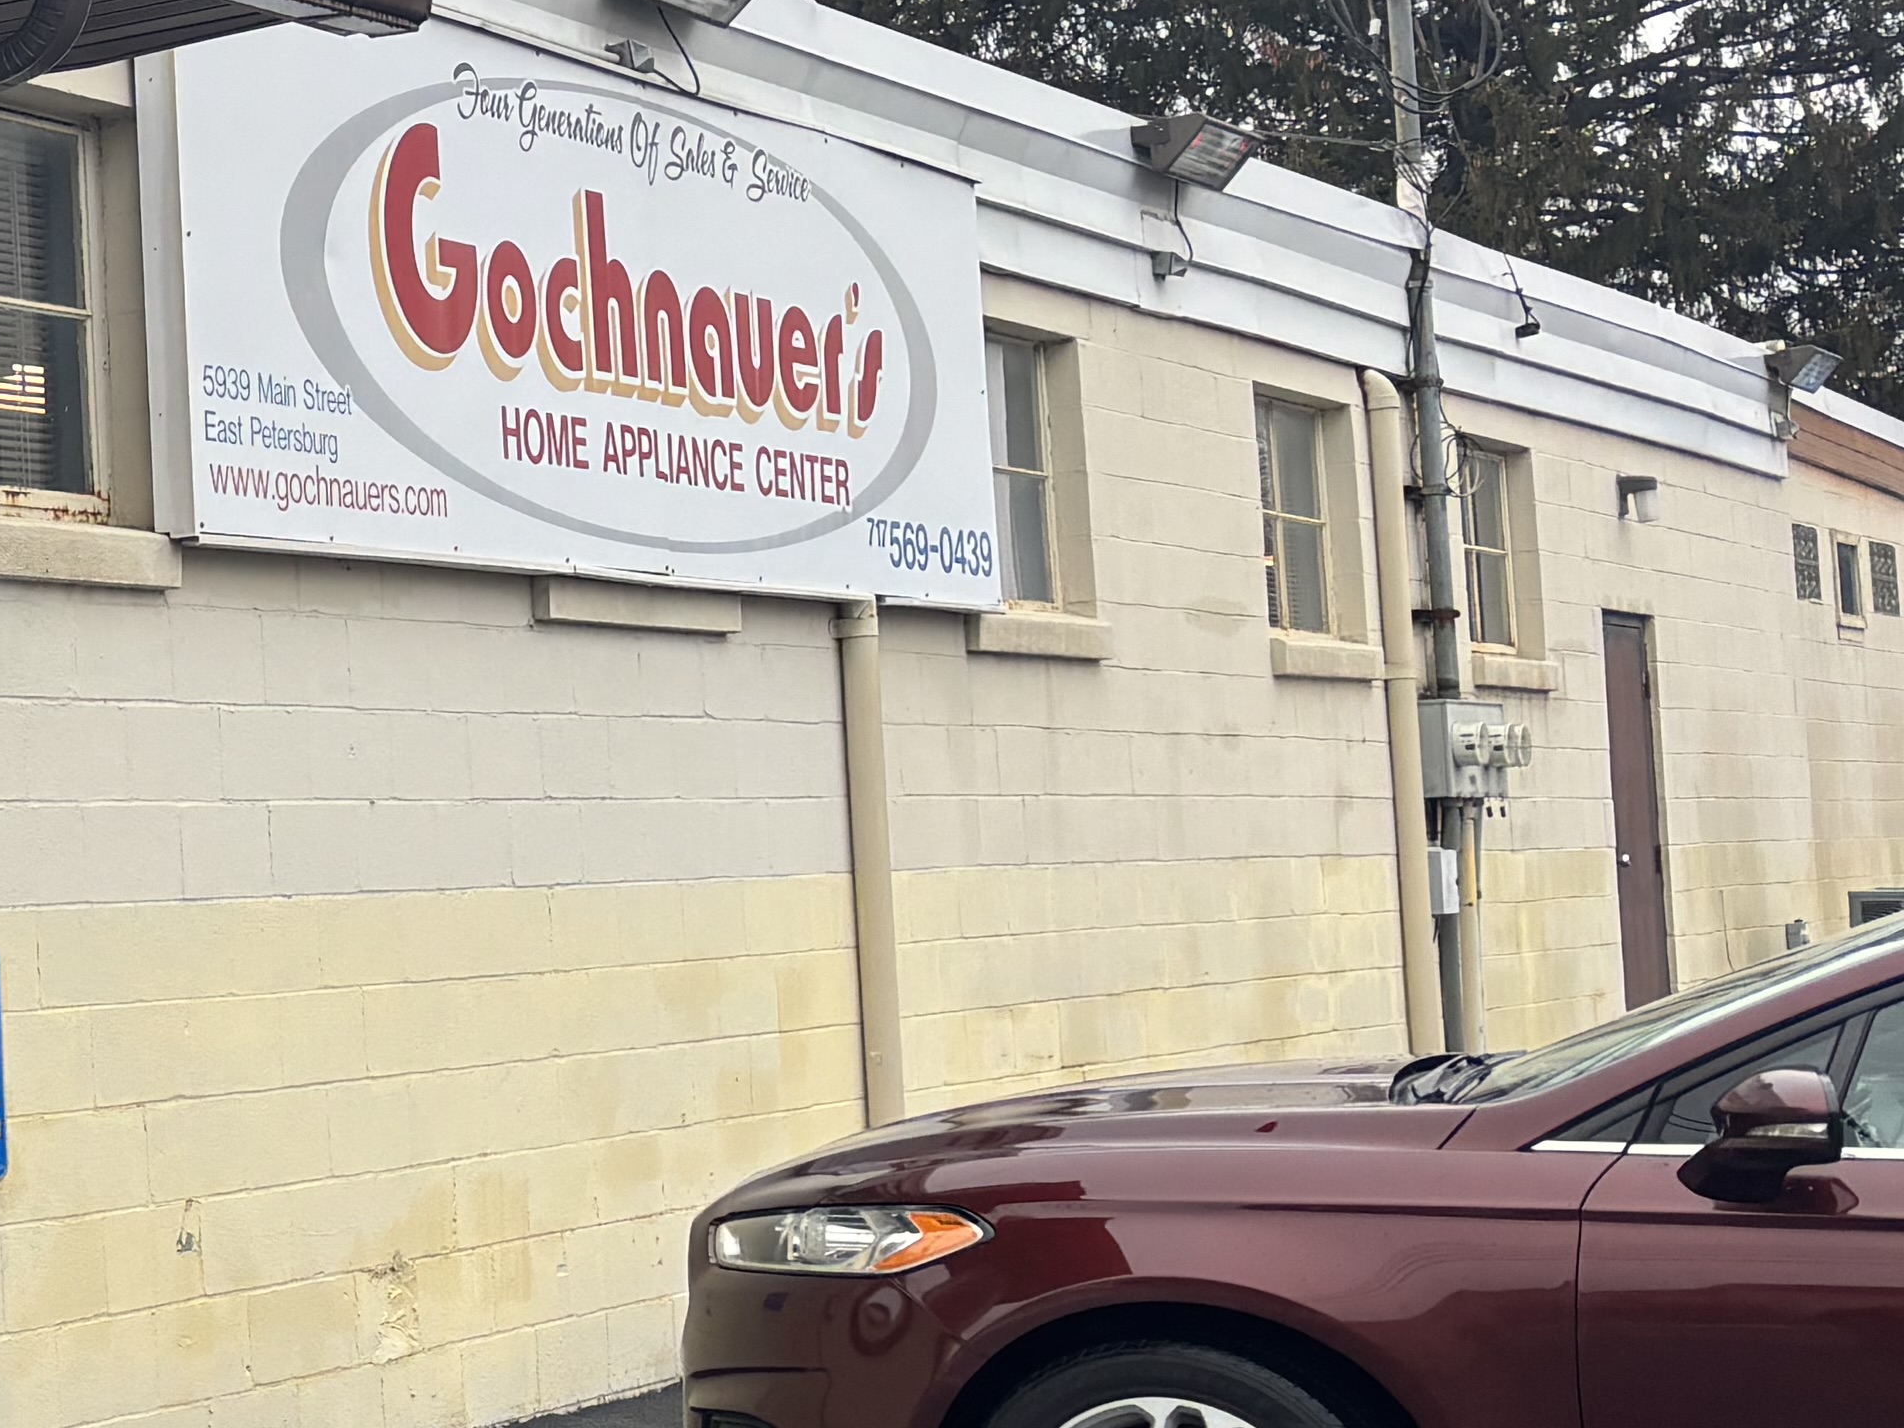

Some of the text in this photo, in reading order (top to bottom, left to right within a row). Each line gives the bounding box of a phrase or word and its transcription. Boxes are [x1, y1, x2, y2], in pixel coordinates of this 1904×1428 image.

[453, 62, 812, 202] Four Generations Of Sales & Service
[370, 123, 883, 438] Gochnauer's
[202, 365, 352, 415] 5939 Main Street
[204, 410, 338, 464] East Petersburg
[501, 405, 851, 506] HOME APPLIANCE CENTER
[209, 463, 448, 518] www.gochnauers.com
[867, 517, 992, 578] 717 569-0439
